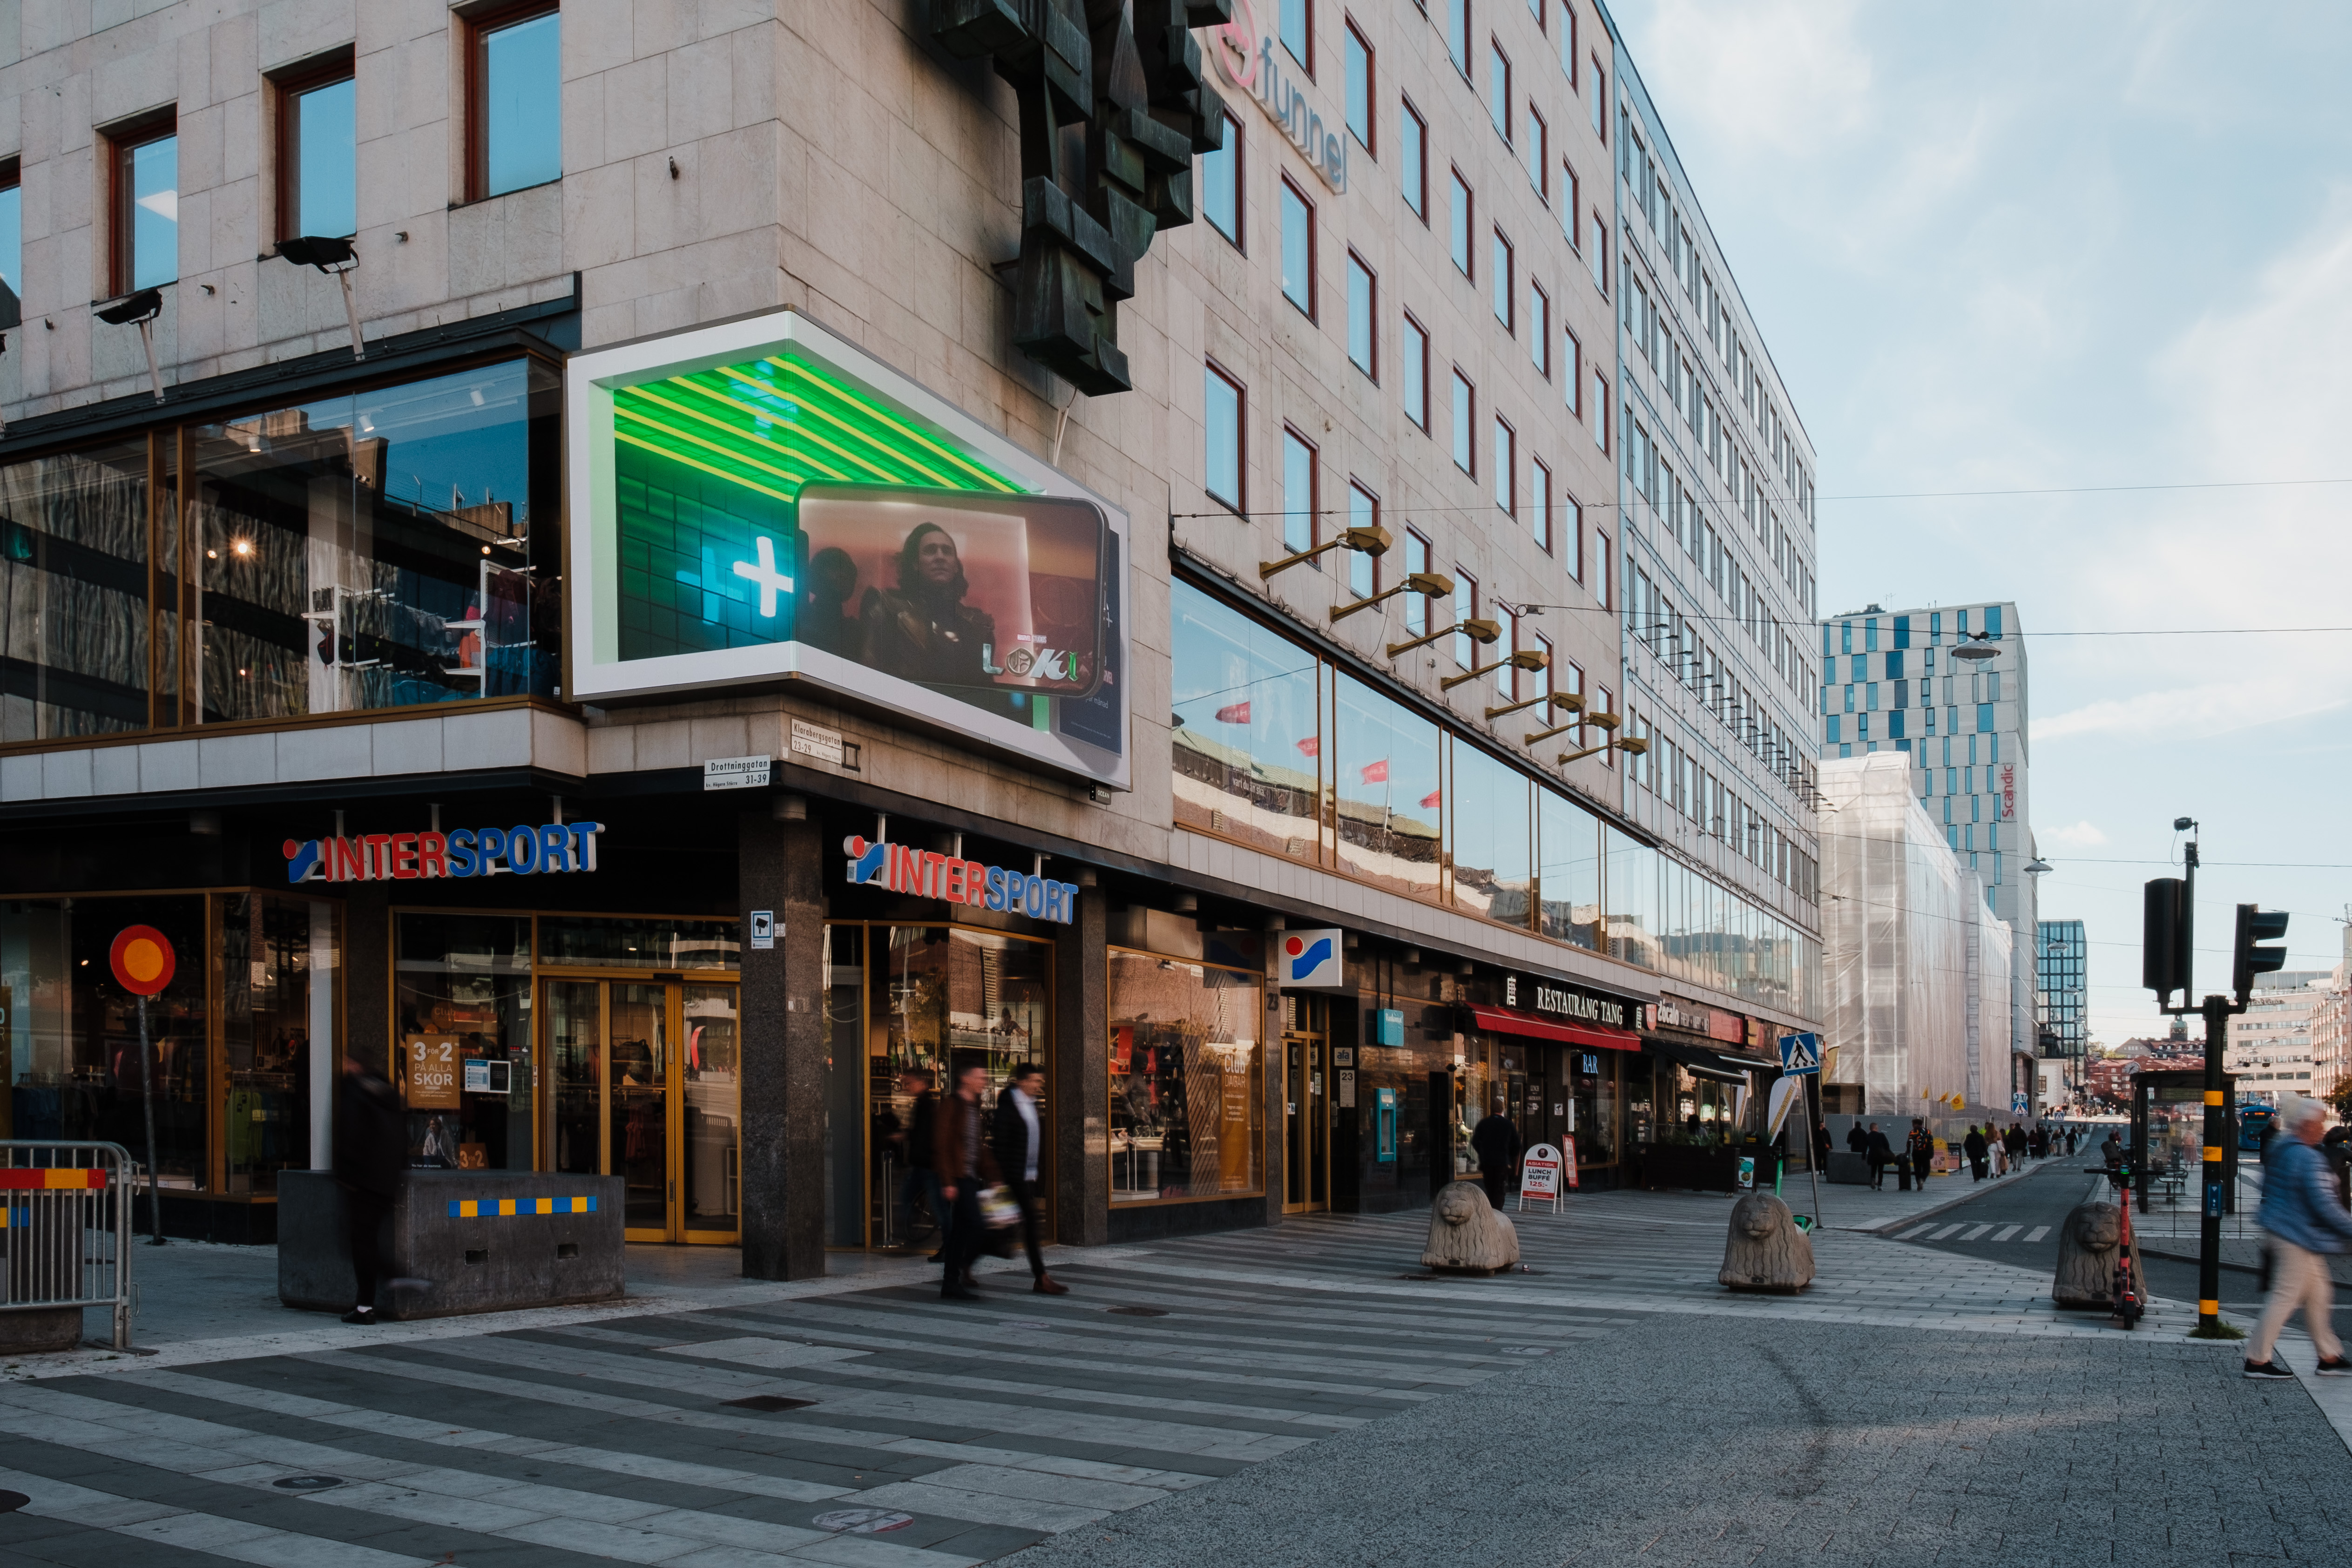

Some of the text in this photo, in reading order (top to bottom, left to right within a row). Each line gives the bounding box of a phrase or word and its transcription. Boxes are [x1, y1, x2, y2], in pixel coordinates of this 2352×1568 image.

[794, 723, 840, 746] Klarabergsgatan
[794, 740, 811, 753] 23-29
[711, 760, 767, 772] Drottninggatan
[745, 775, 767, 784] 31-39
[2001, 765, 2014, 817] Scandic
[324, 822, 598, 882] INTERSPORT
[890, 843, 1079, 925] INTERSPORT
[1267, 992, 1279, 1011] 23
[1537, 986, 1598, 1020] RESTAURANG
[1601, 1001, 1623, 1025] TANG
[413, 1041, 426, 1061] 3
[439, 1042, 453, 1061] 2
[1337, 1049, 1349, 1060] afa
[414, 1061, 453, 1072] PÅ ALLA
[1224, 1054, 1246, 1074] Club
[1583, 1054, 1598, 1075] BAR
[414, 1073, 453, 1086] SKOR
[1224, 1075, 1246, 1088] DAGAR
[1342, 1072, 1353, 1081] 23
[460, 1150, 469, 1168] 3
[475, 1150, 484, 1167] 2
